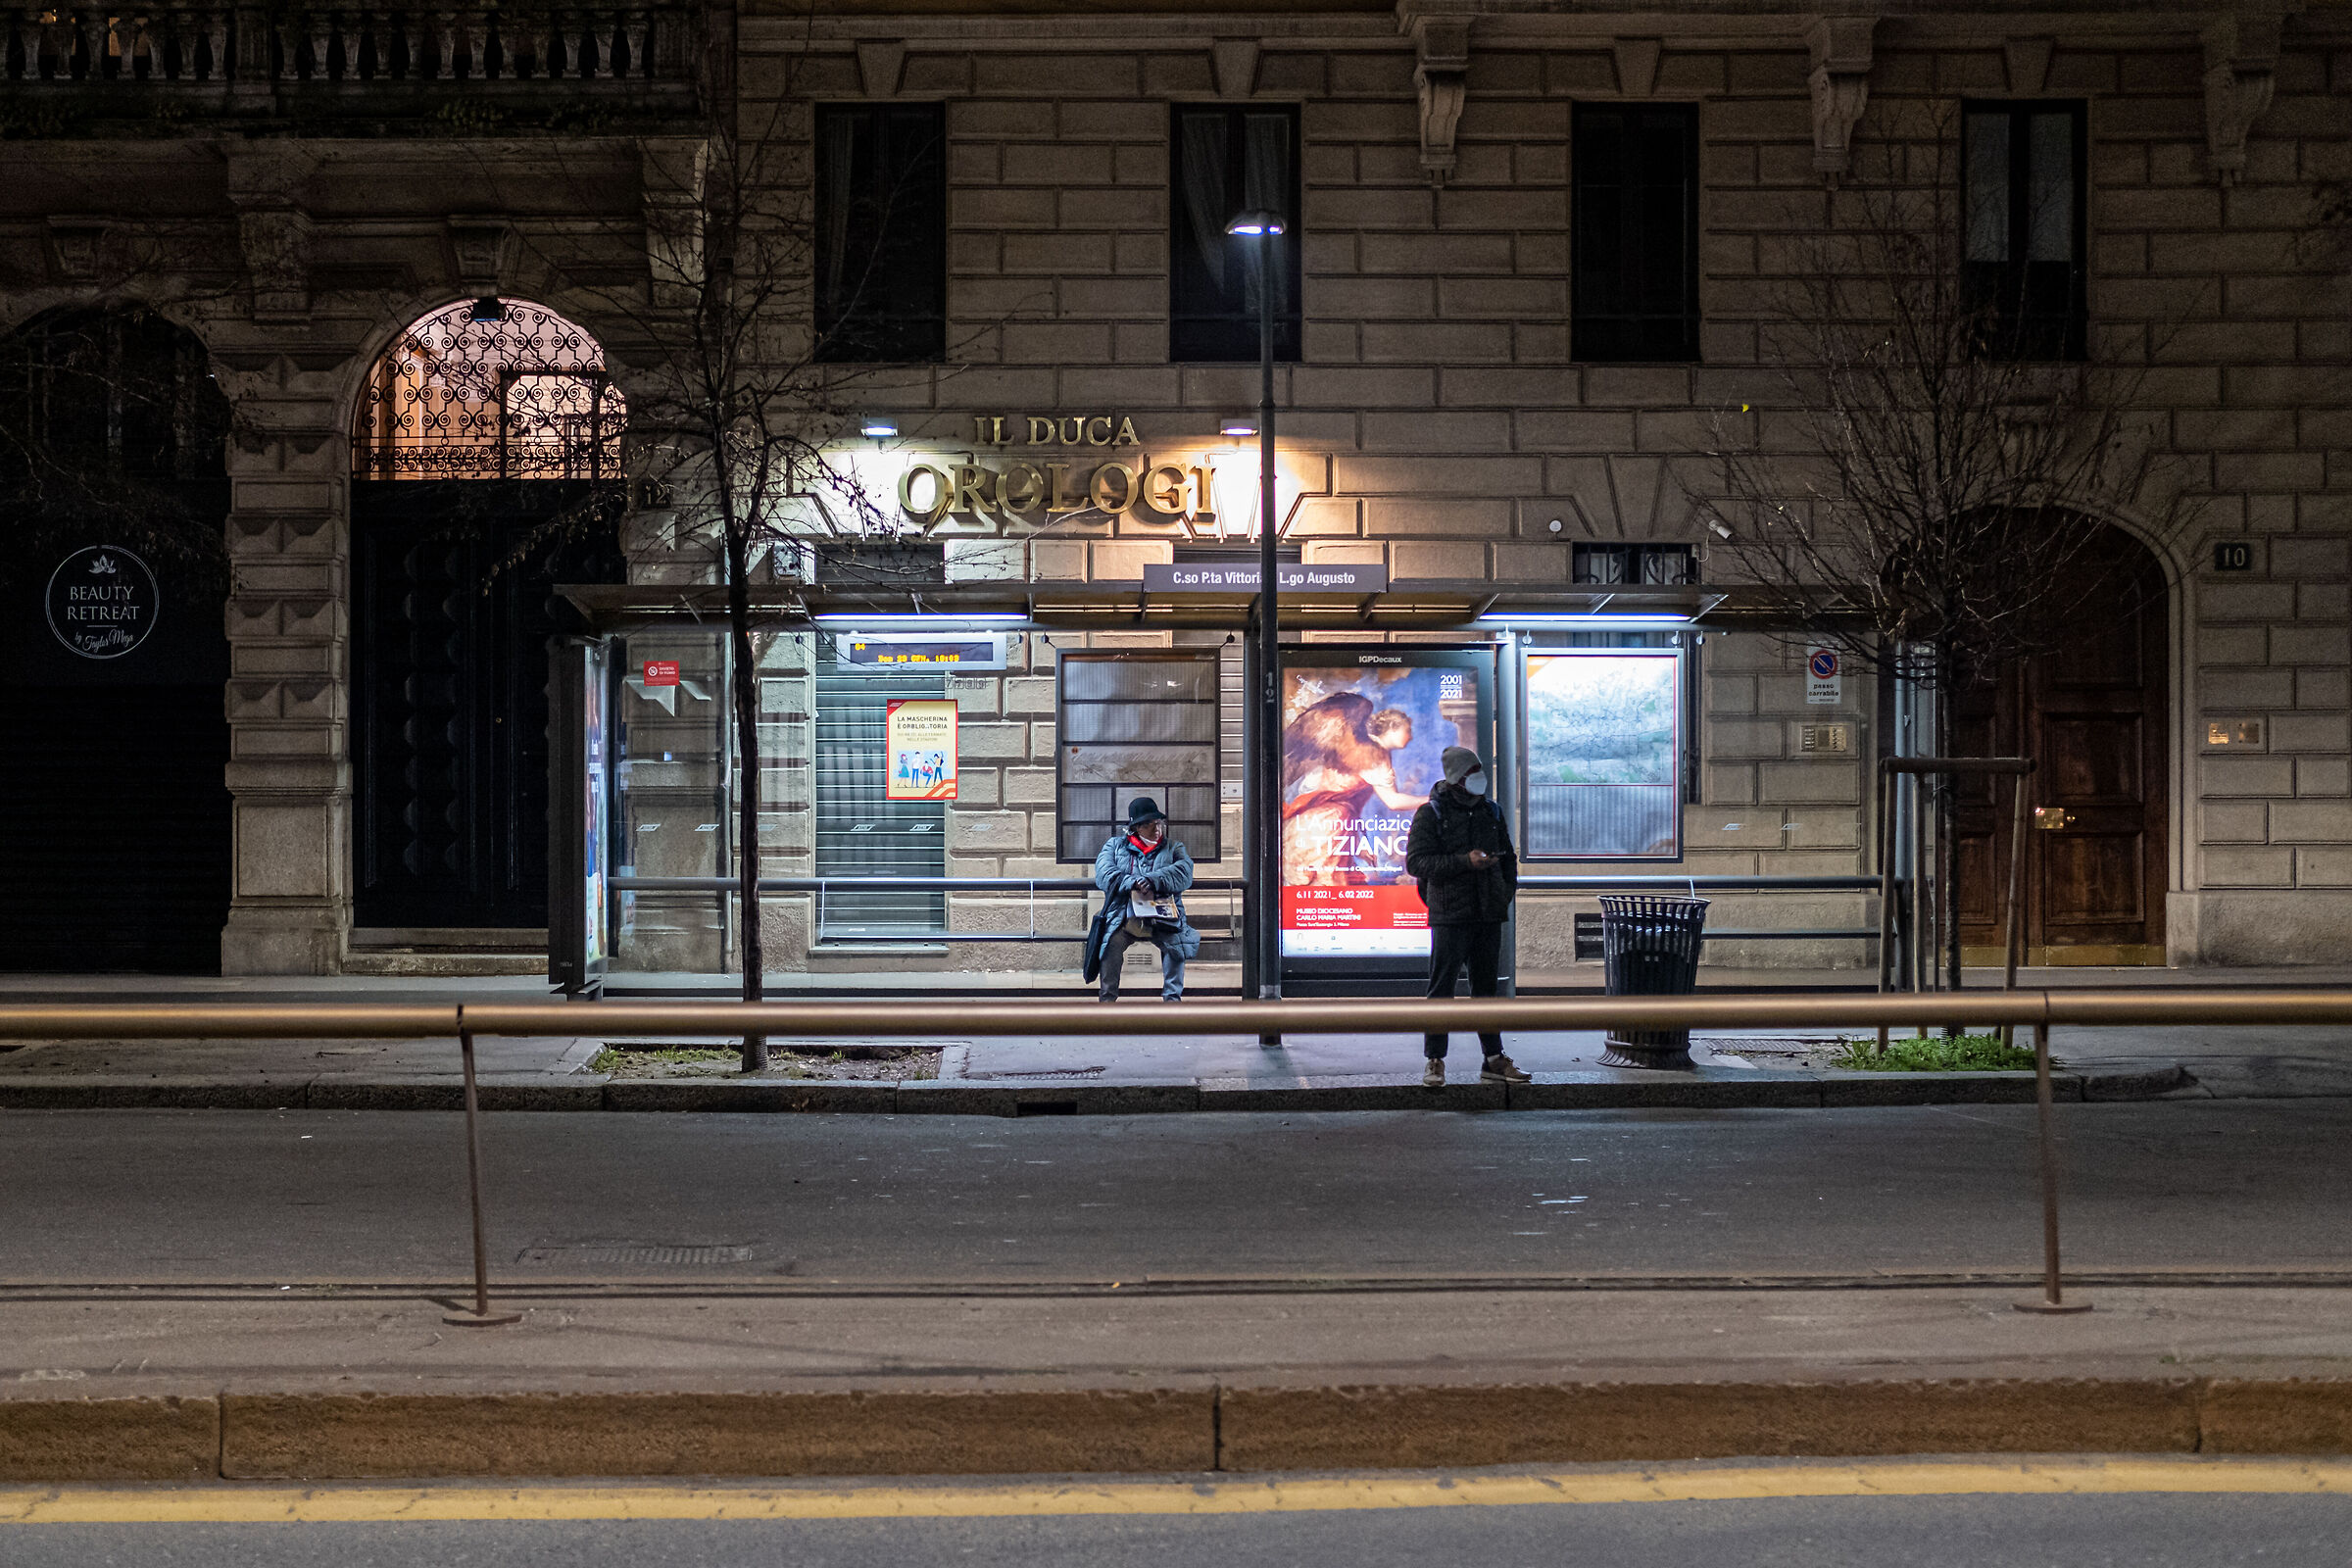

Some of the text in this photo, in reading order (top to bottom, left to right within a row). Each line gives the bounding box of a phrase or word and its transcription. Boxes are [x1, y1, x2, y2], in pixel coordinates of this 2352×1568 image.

[973, 416, 1141, 446] IL DUCA
[897, 462, 1217, 514] OROLOGI
[2225, 547, 2245, 566] 10
[1173, 571, 1199, 584] C.so
[1201, 571, 1222, 584] P.ta
[1279, 571, 1304, 586] L.go
[1306, 571, 1355, 586] Augusto
[70, 586, 134, 601] BEAUTY
[67, 606, 140, 620] RETREAT
[1440, 674, 1463, 685] 2001
[1440, 689, 1463, 699] 2021
[1296, 814, 1411, 832] L'Annunciazio
[1296, 890, 1311, 899] 6.11
[1338, 890, 1354, 899] 6.02
[1355, 890, 1374, 899] 2022
